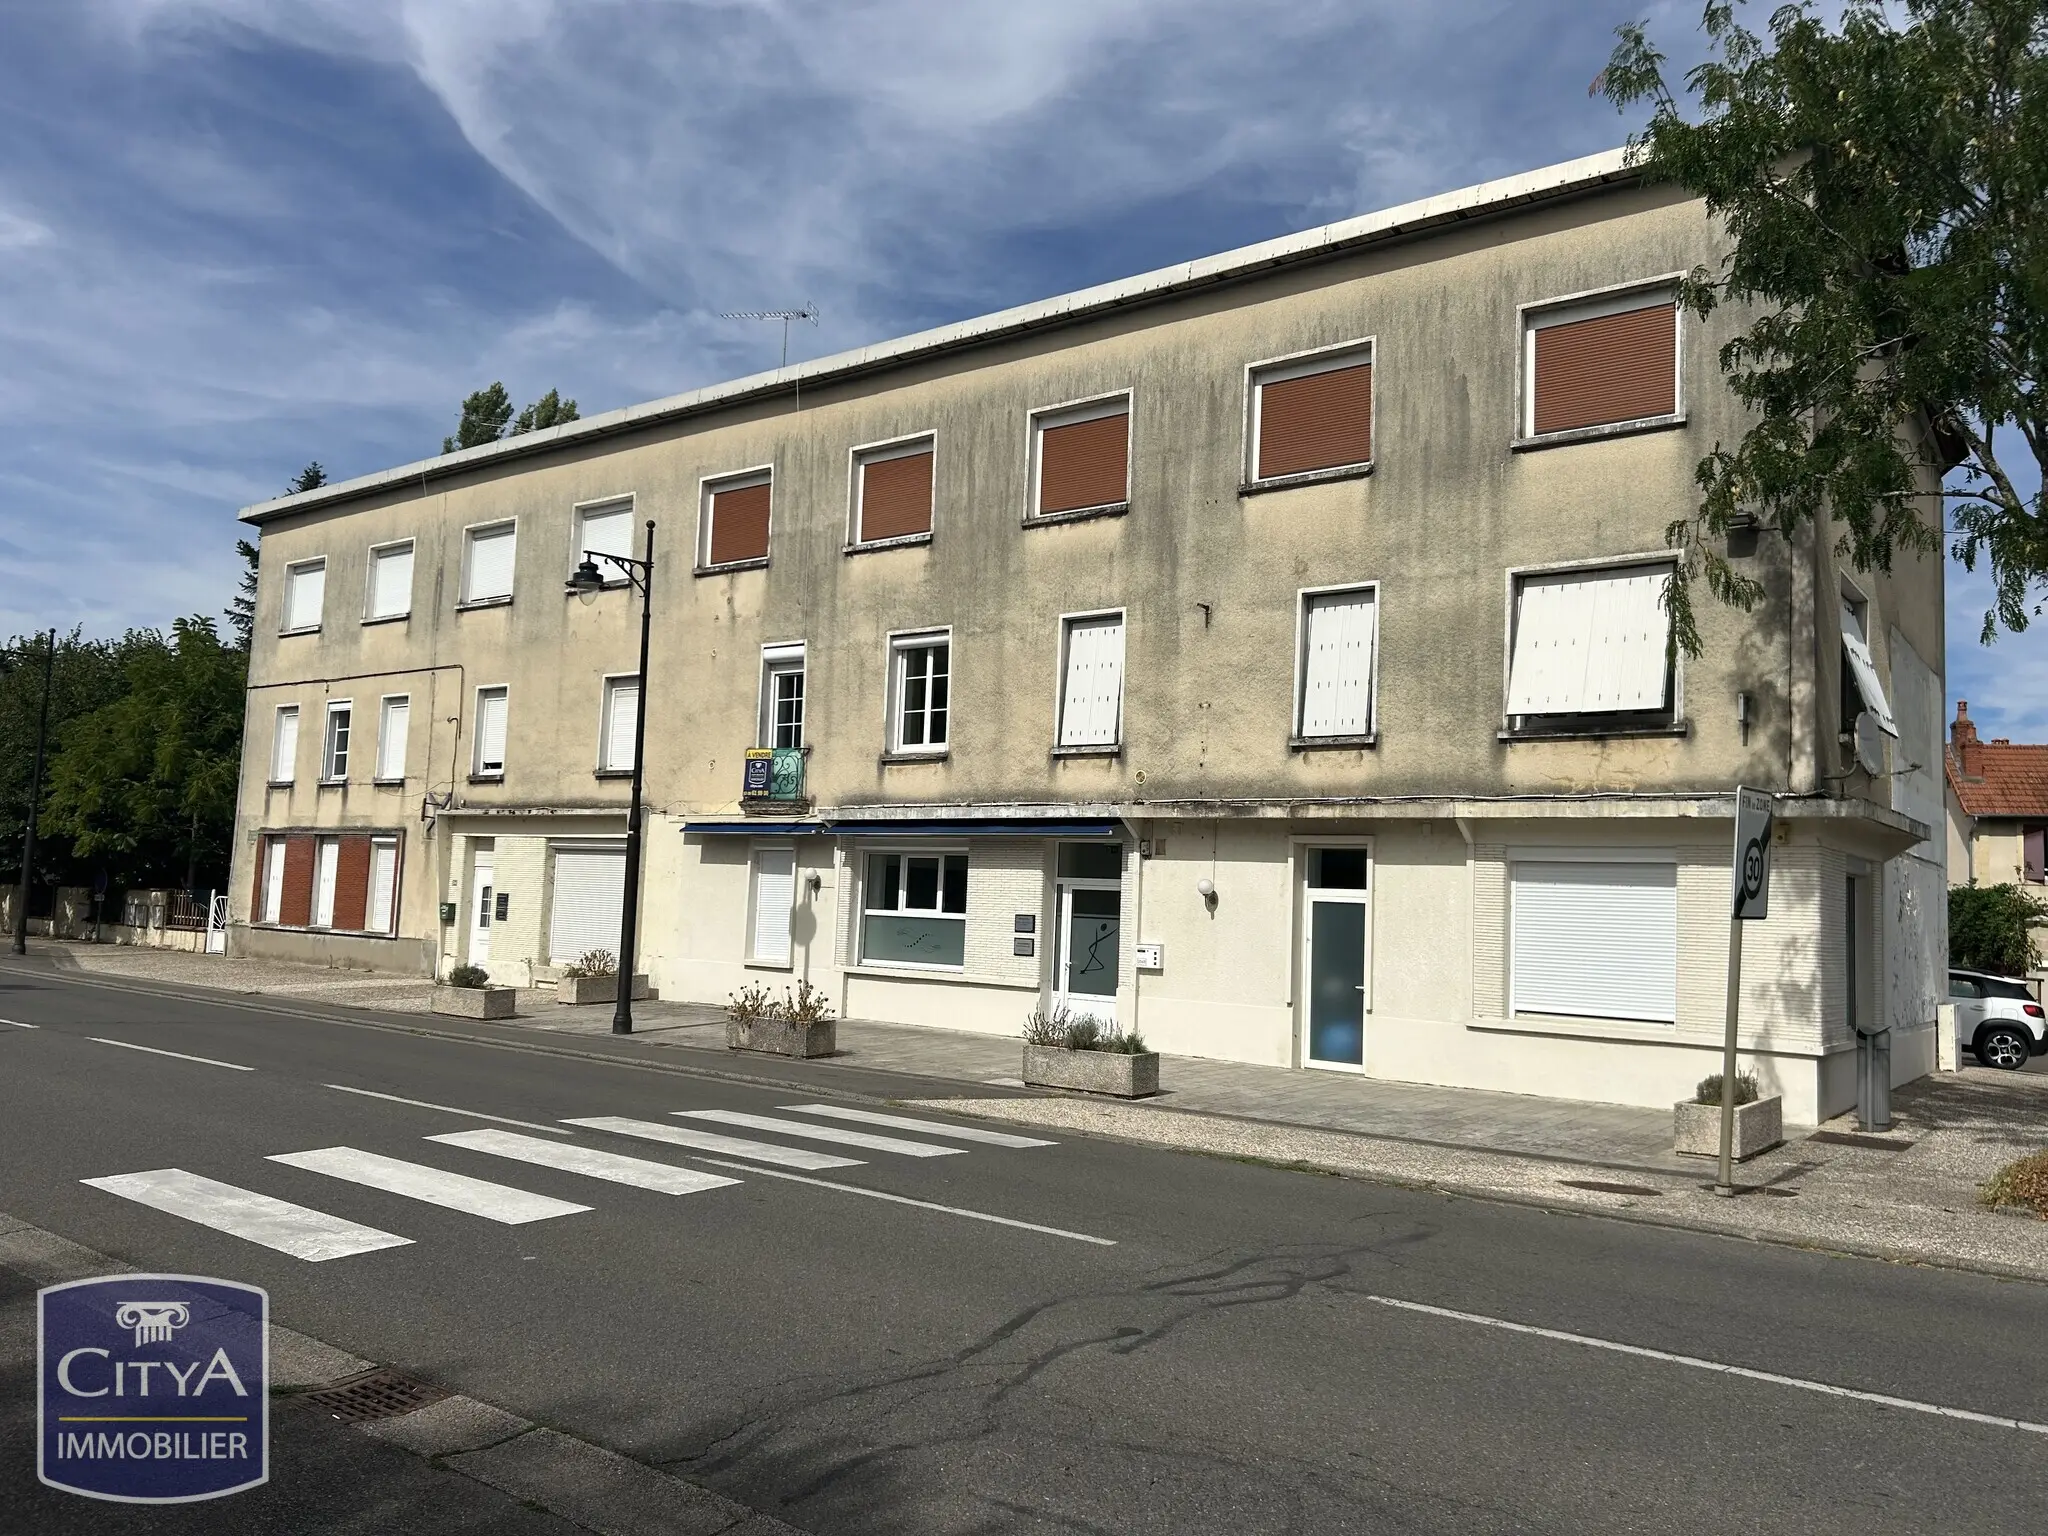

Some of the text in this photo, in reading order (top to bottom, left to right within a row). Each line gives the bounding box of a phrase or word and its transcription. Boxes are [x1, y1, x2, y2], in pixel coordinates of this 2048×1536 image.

[1742, 795, 1751, 808] FIN
[1756, 798, 1770, 812] ZONE
[1747, 856, 1760, 882] 30
